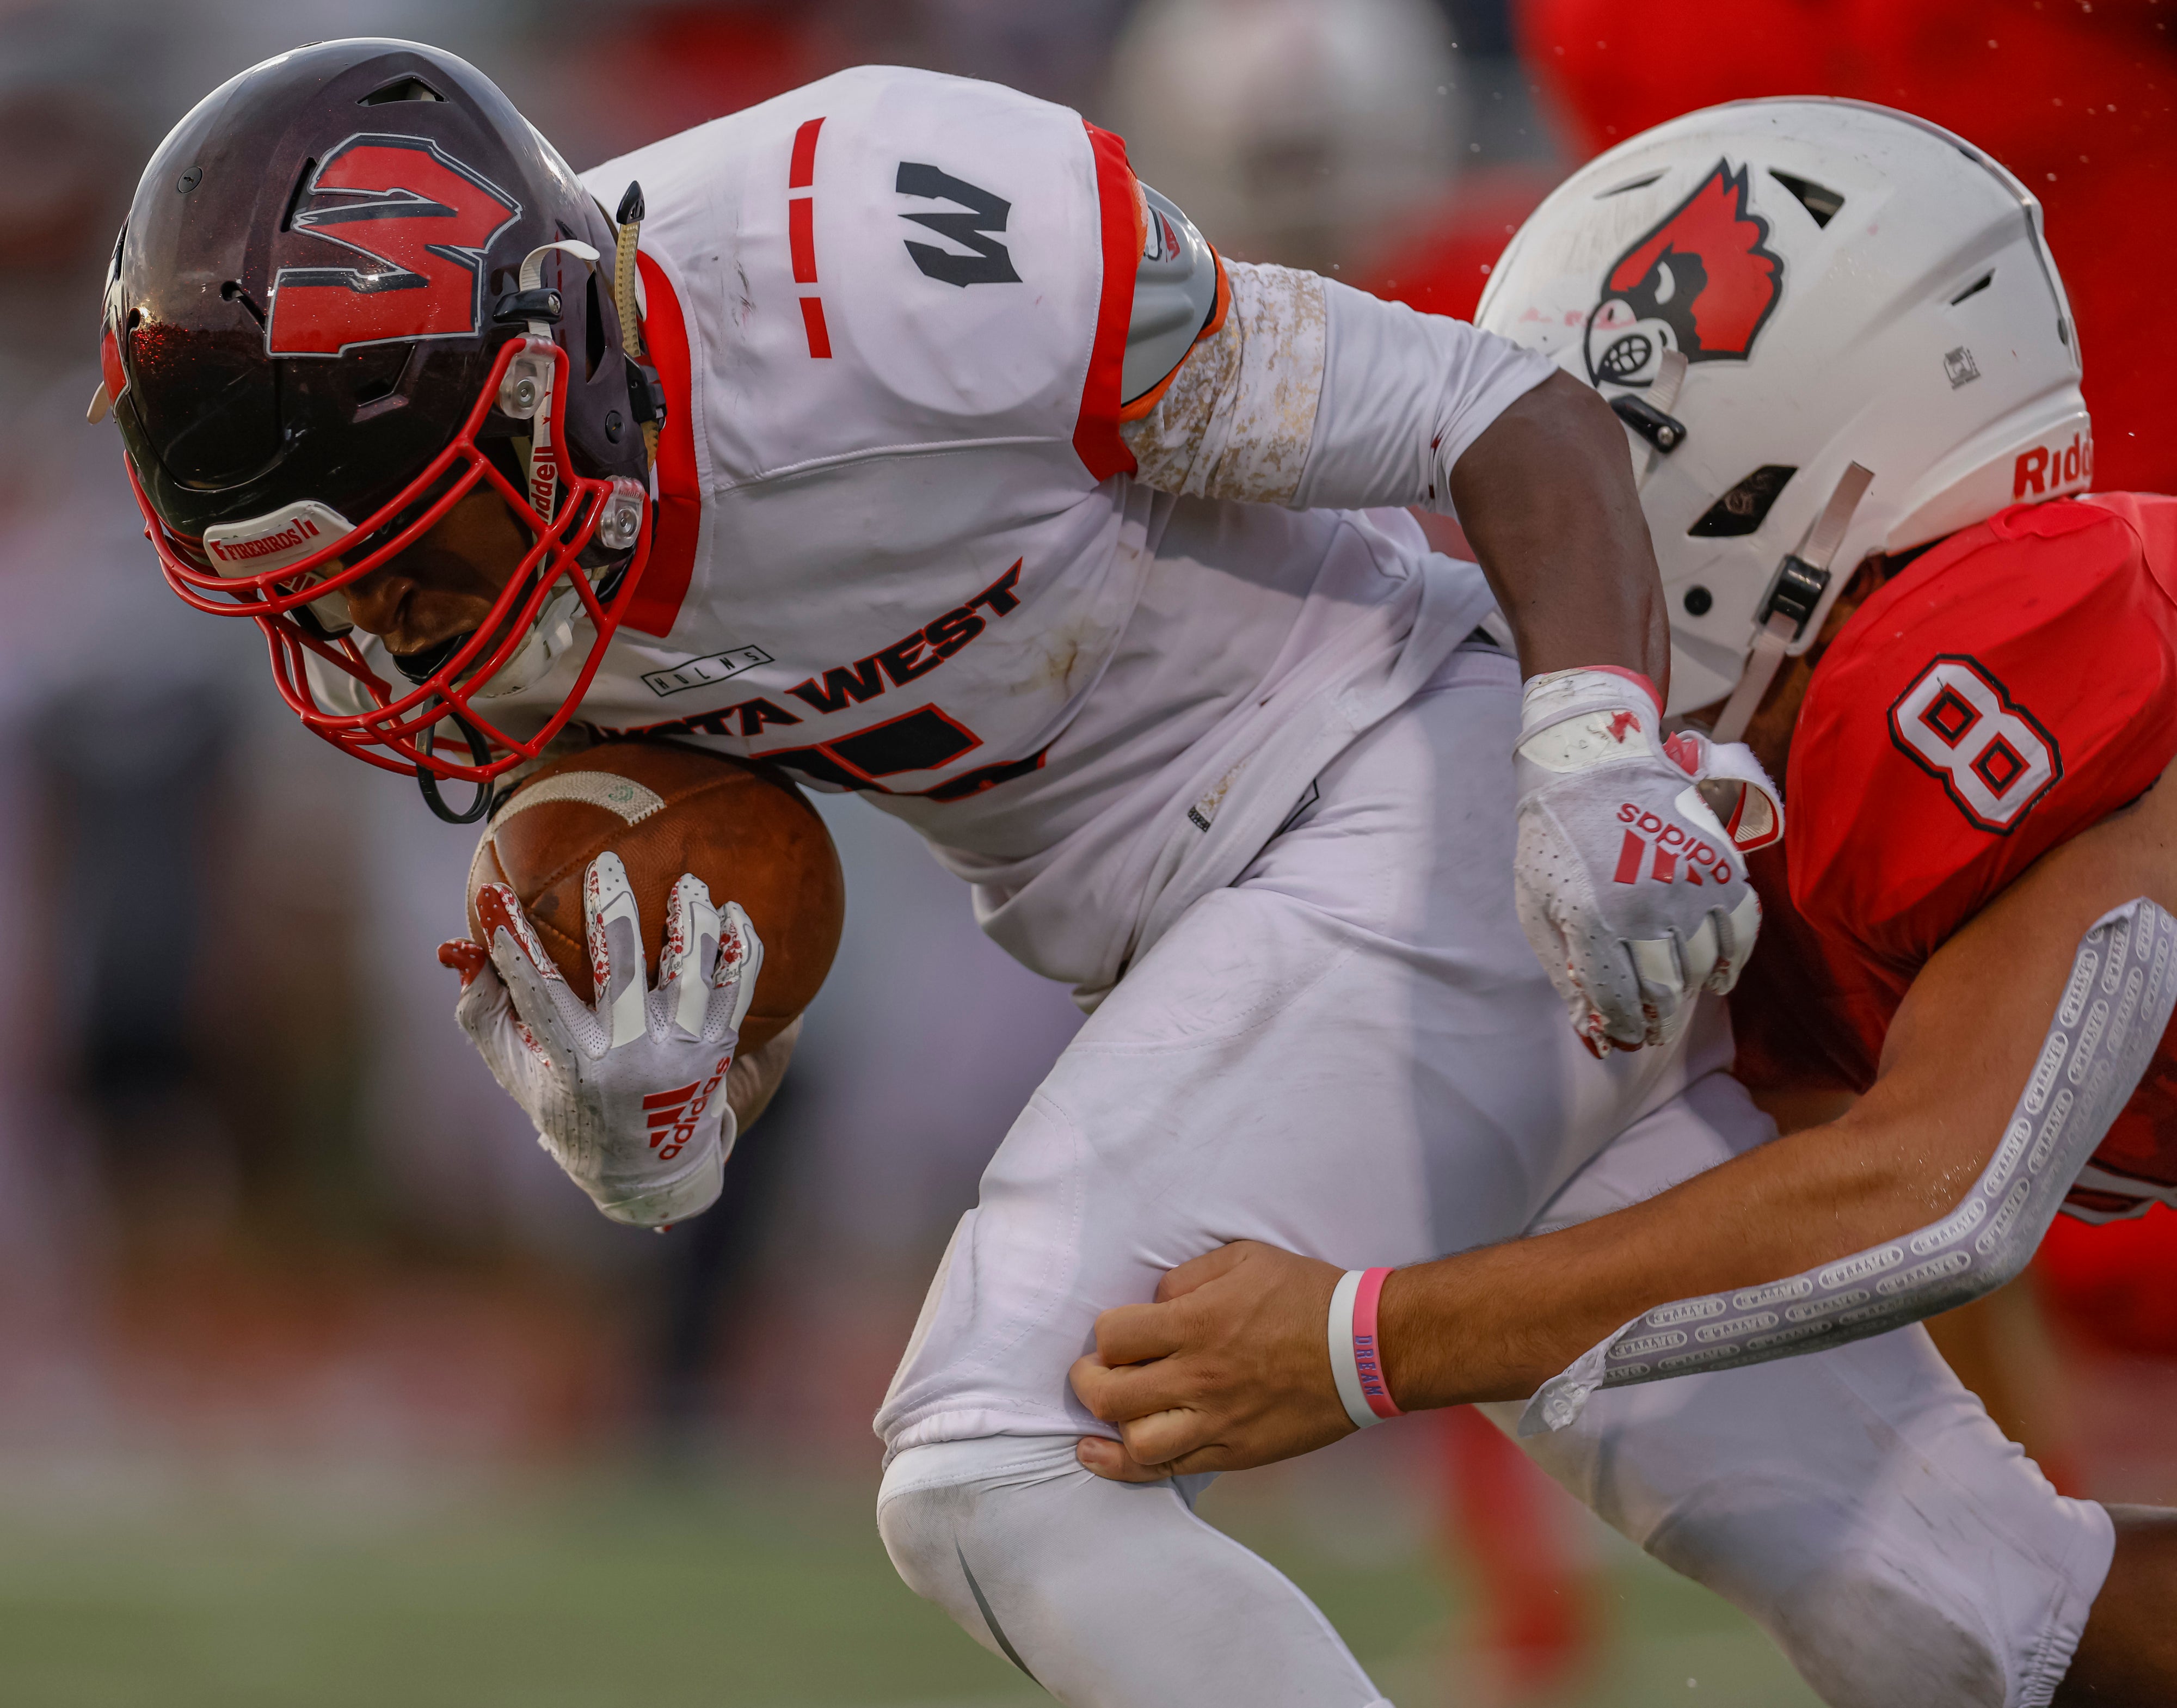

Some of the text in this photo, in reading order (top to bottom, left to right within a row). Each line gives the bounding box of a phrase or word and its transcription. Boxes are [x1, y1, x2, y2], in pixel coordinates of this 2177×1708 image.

[531, 446, 556, 525] iddell
[224, 527, 303, 561] FIREBIRDS
[785, 556, 1023, 715] WEST
[1887, 654, 2064, 837] 8
[1616, 803, 1732, 884] adidas
[659, 1056, 731, 1160] adidas
[1355, 1335, 1385, 1396] DREAM
